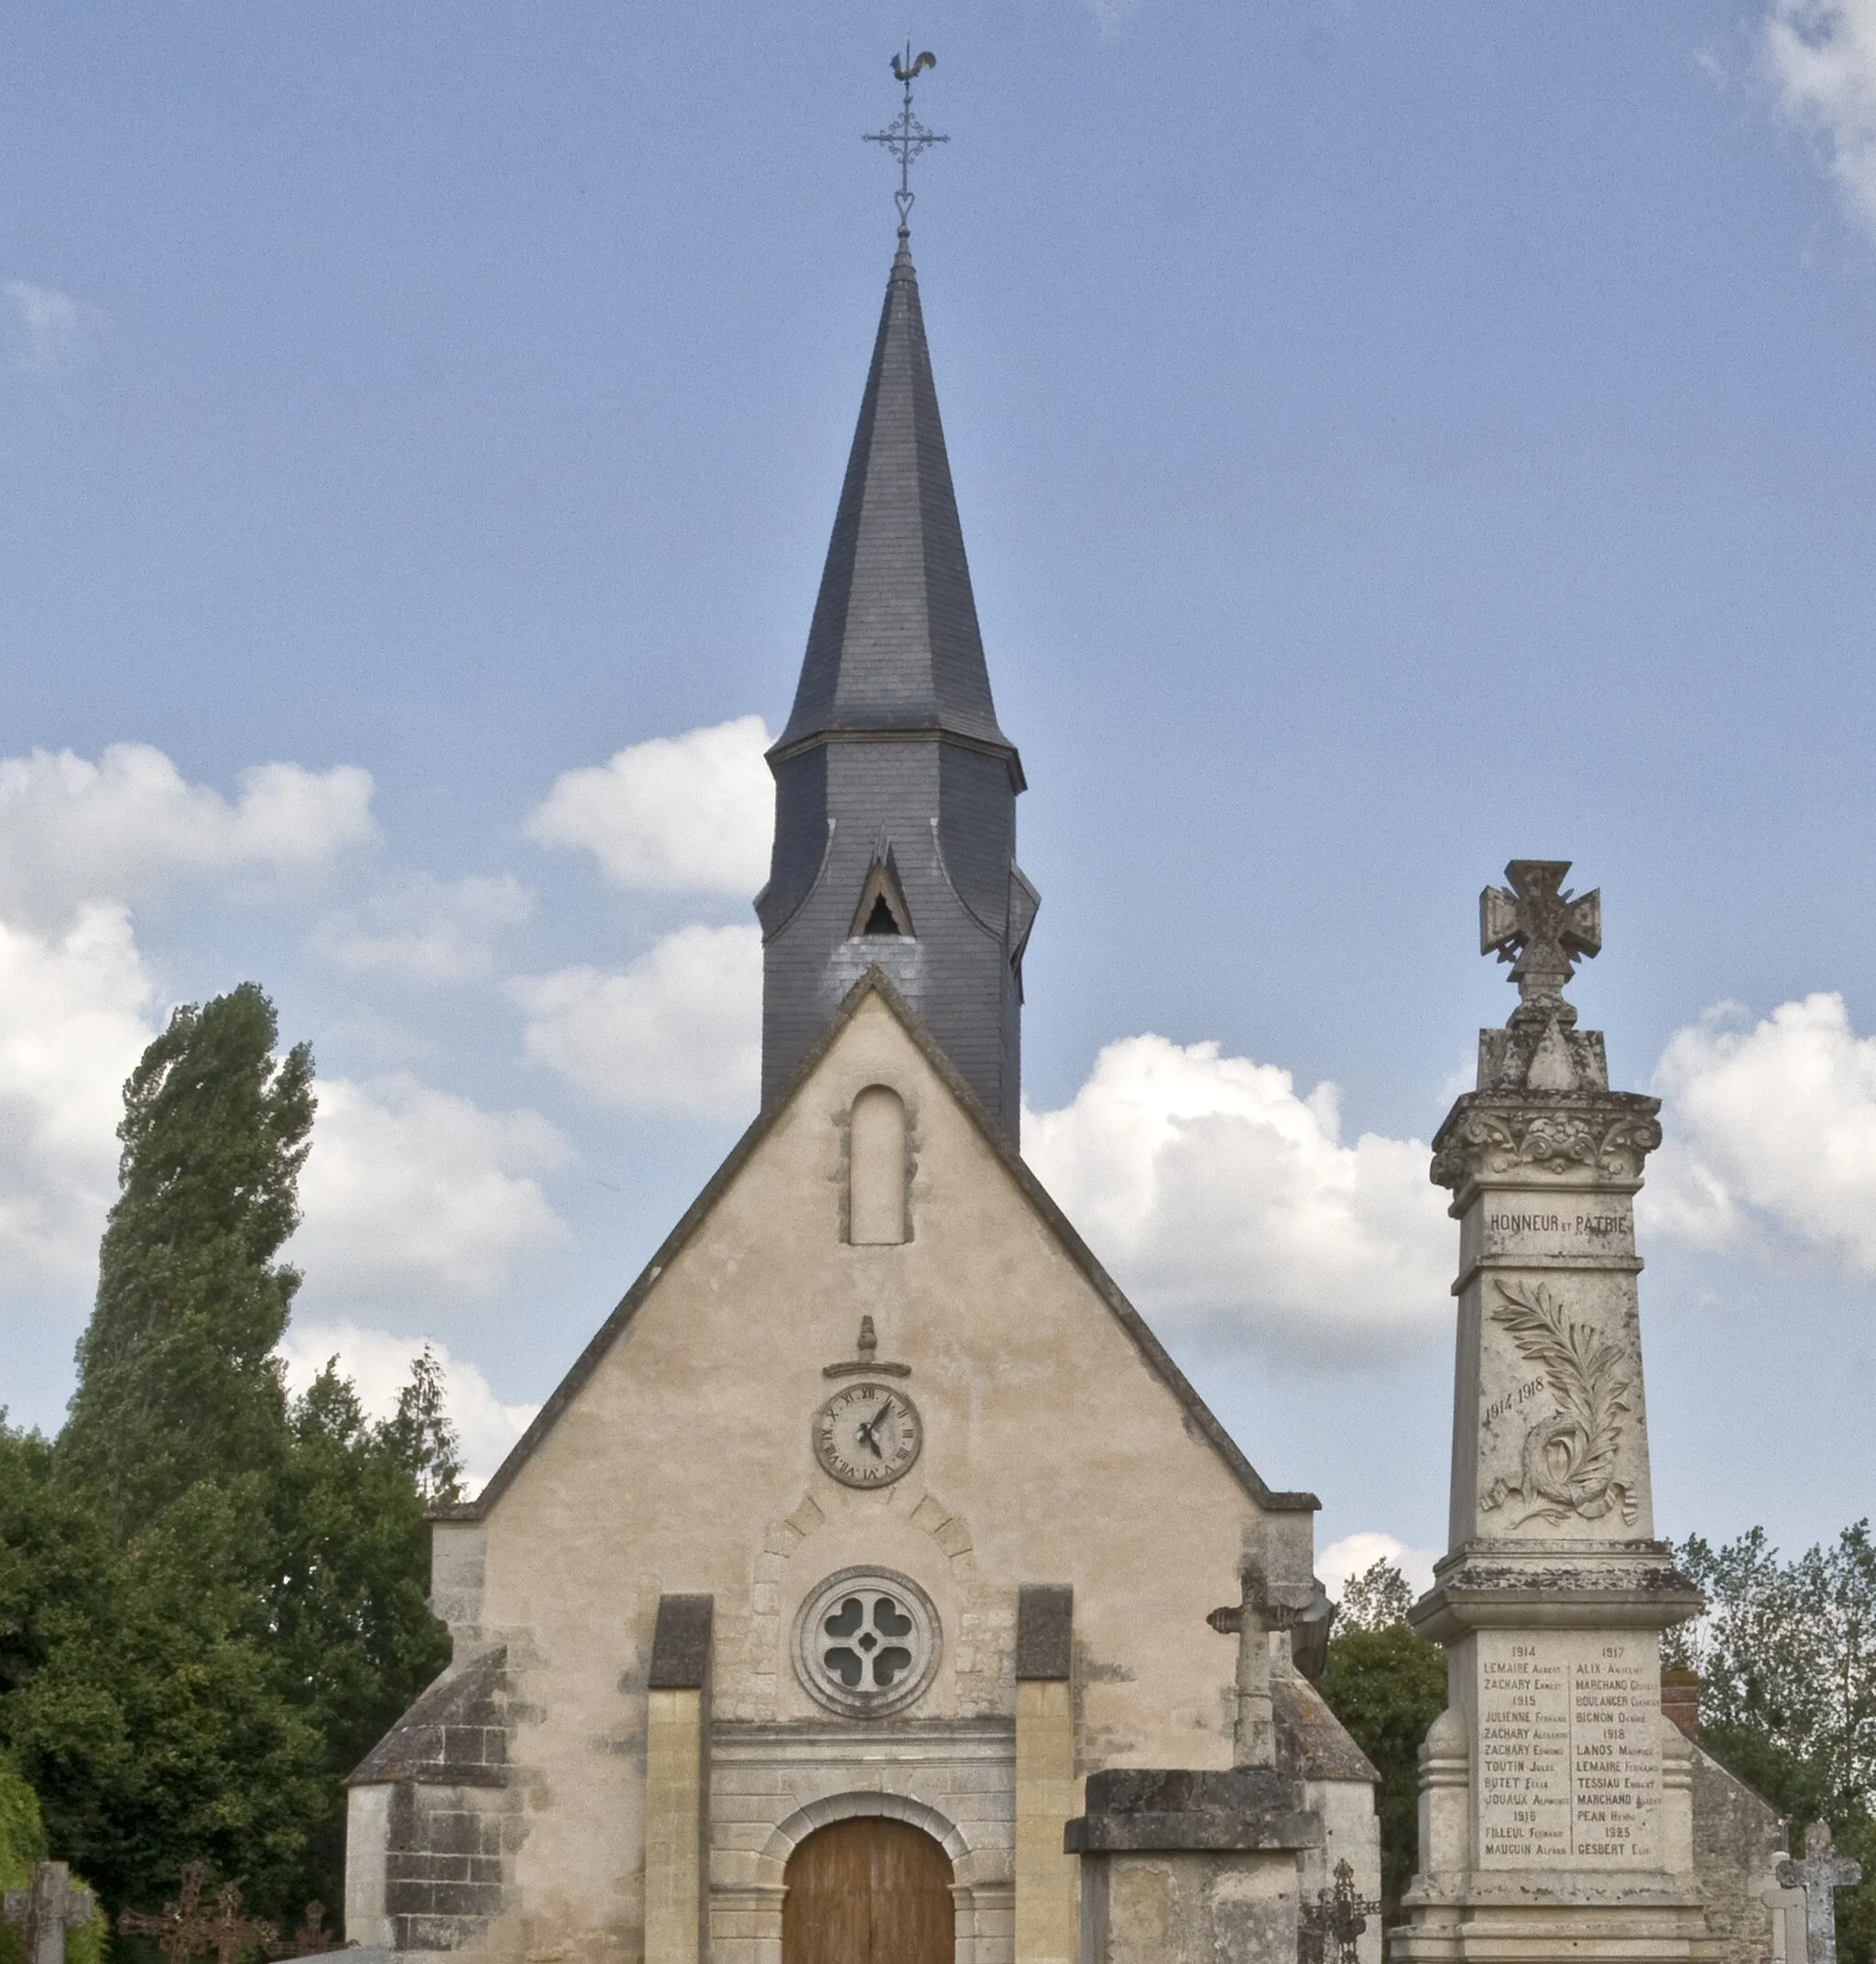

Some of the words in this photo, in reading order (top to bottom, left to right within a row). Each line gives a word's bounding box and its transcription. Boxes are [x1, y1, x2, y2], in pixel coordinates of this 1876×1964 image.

[1490, 1215, 1558, 1231] HONNEUR
[1562, 1223, 1572, 1231] ET
[1576, 1216, 1626, 1233] PATRIE
[1511, 1647, 1536, 1657] 1914
[1602, 1648, 1624, 1657] 1917
[1484, 1664, 1529, 1673] LEMAIRE
[1576, 1664, 1601, 1674] ALIX
[1484, 1679, 1531, 1689] ZACHARY
[1576, 1681, 1627, 1690] MARCHAND
[1512, 1696, 1536, 1706] 1915
[1576, 1697, 1628, 1707] BOULANGER
[1485, 1711, 1530, 1722] JULIENNE
[1576, 1712, 1614, 1723] BIGNON
[1484, 1729, 1530, 1739] ZACHARY
[1603, 1729, 1625, 1740] 1918
[1484, 1745, 1530, 1755] ZACHARY
[1576, 1745, 1613, 1756] LANOS
[1485, 1761, 1524, 1772] TOUTIN
[1576, 1762, 1621, 1772] LEMAIRE
[1485, 1778, 1520, 1788] BUTET
[1577, 1778, 1620, 1788] TESSIAU
[1485, 1795, 1528, 1805] JOUAUX
[1577, 1795, 1631, 1805] MARCHAND
[1514, 1811, 1536, 1821] 1916
[1577, 1811, 1605, 1821] PEAN
[1486, 1828, 1524, 1838] FILLEUL
[1606, 1828, 1631, 1838] 1925
[1485, 1844, 1531, 1855] MAUGUIN
[1578, 1844, 1624, 1855] GESBERT
